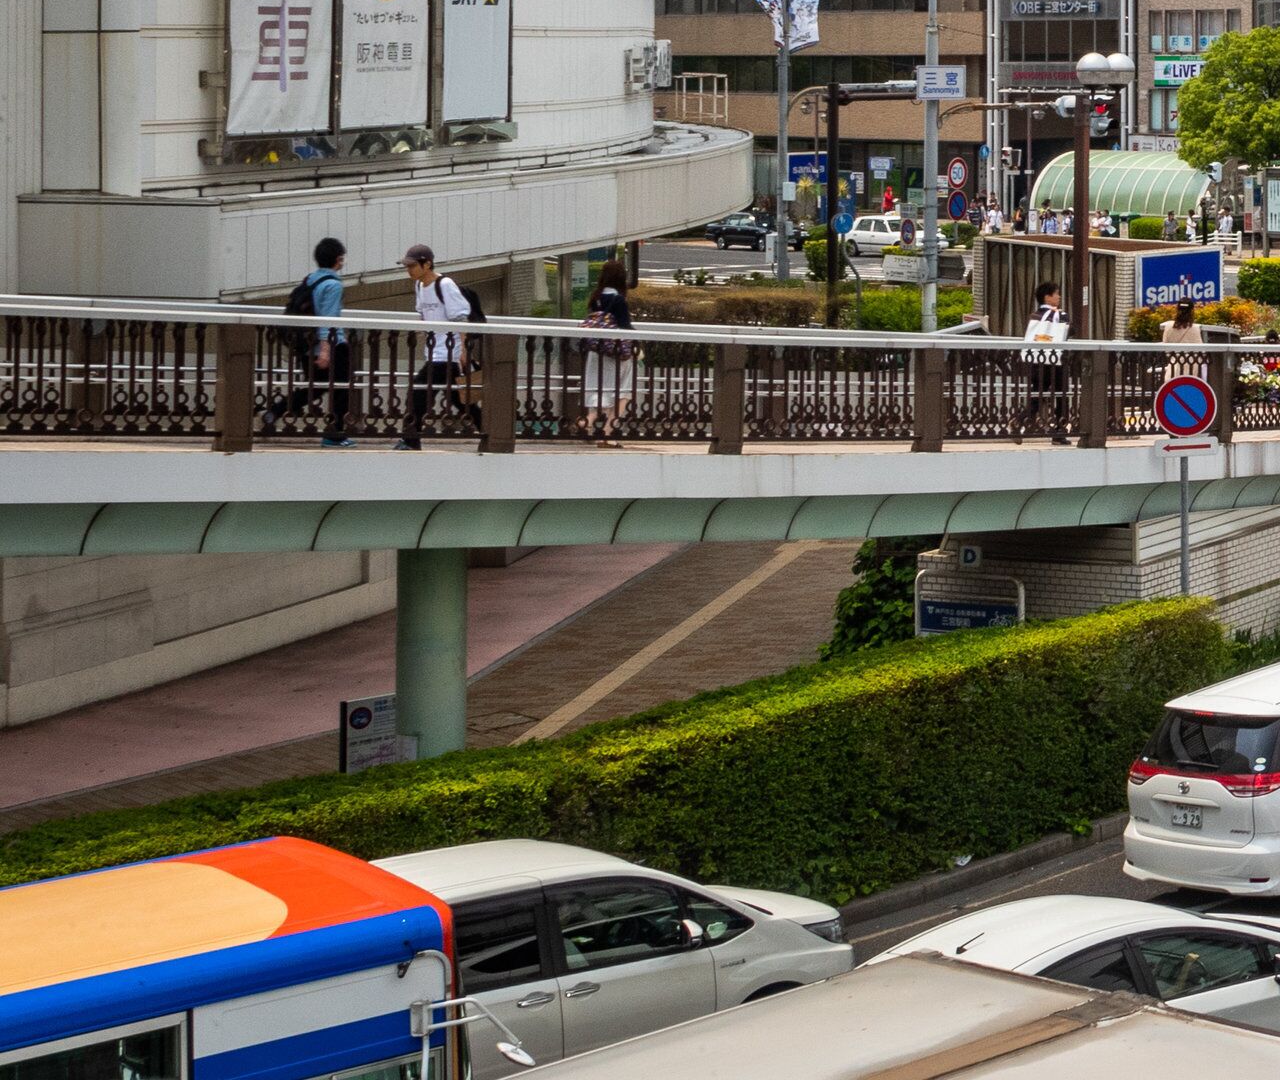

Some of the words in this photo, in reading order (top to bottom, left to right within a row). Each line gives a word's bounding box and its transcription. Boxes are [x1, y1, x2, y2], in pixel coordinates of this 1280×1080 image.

[1011, 1, 1041, 14] KOBE
[1044, 0, 1097, 15] 三宮センター街
[356, 41, 413, 65] 阪神電車
[923, 71, 960, 86] 三宮
[922, 86, 960, 95] Sannomiya
[952, 166, 964, 180] 50
[1145, 274, 1216, 305] santica
[963, 547, 977, 564] D
